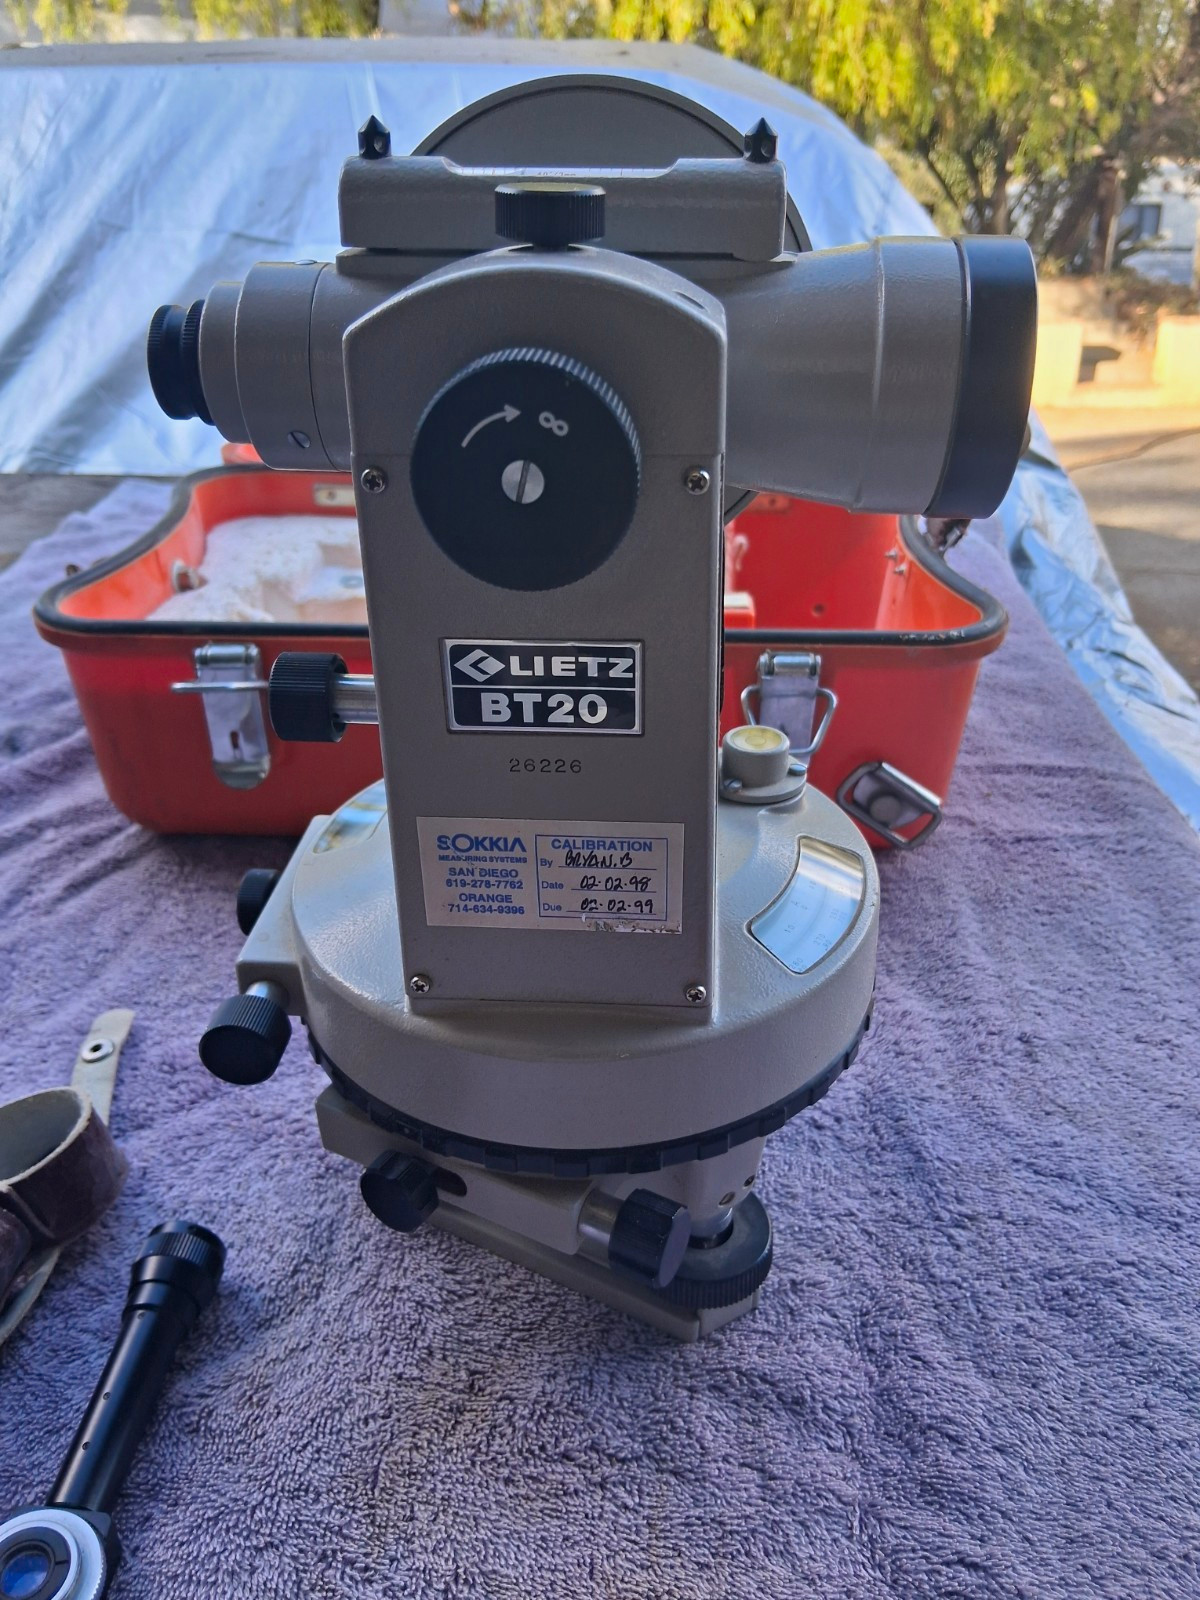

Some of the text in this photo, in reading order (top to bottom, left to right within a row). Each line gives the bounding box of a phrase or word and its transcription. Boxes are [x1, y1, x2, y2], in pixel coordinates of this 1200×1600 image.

[510, 655, 633, 678] LIETZ
[480, 692, 608, 724] BT20
[509, 758, 582, 773] 26226
[437, 833, 527, 853] SOKKIA
[551, 838, 653, 852] CALIBRATION
[438, 854, 527, 864] MEASURING SYSTEMS
[540, 858, 553, 868] By
[448, 867, 519, 878] SAN DIEGO
[446, 878, 524, 889] 619-278-7762
[541, 880, 564, 890] Date
[459, 893, 513, 903] ORANGE
[448, 903, 525, 915] 714-634-9396
[542, 903, 562, 912] Due
